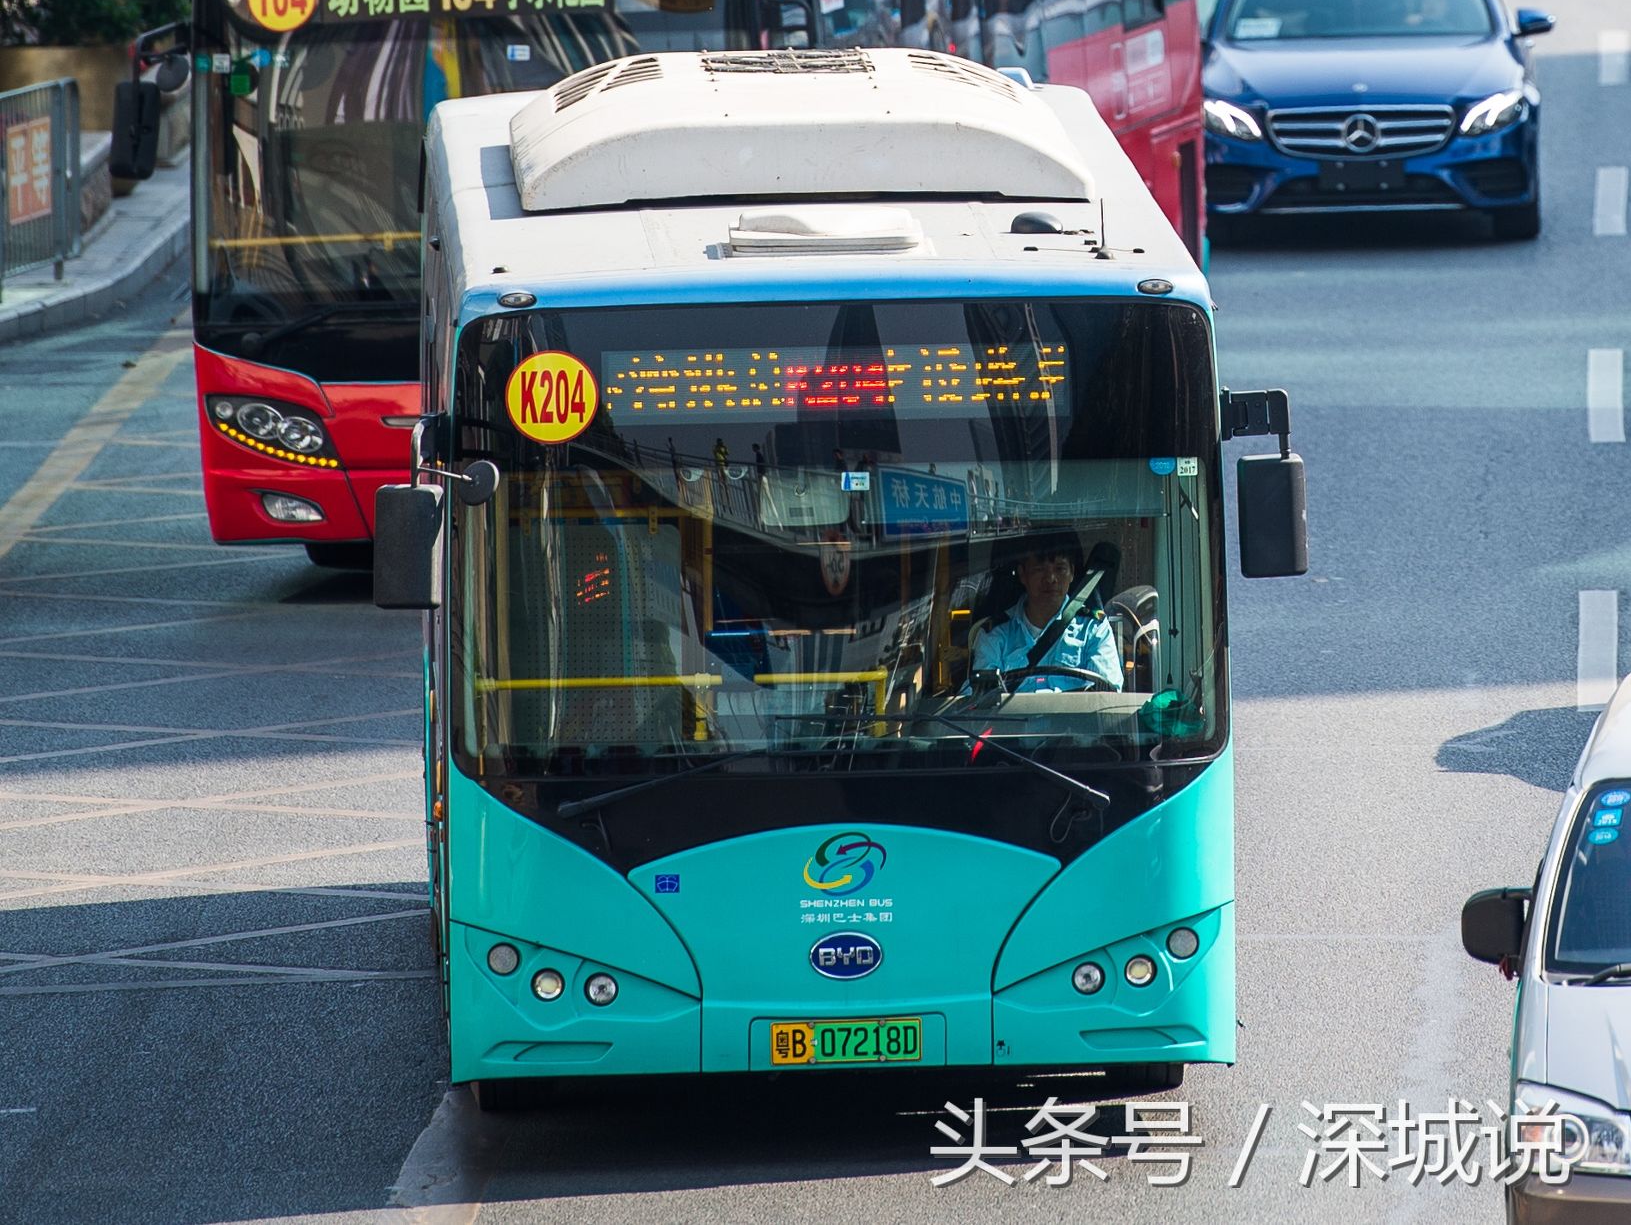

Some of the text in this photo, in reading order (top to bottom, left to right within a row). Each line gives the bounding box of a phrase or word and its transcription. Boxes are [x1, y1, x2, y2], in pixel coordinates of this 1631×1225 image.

[521, 369, 586, 424] K204
[800, 898, 893, 908] SHENZHEN BUS
[800, 912, 893, 924] 深圳巴士集团
[818, 947, 873, 966] BYD
[776, 1026, 918, 1058] 粤B 07218D
